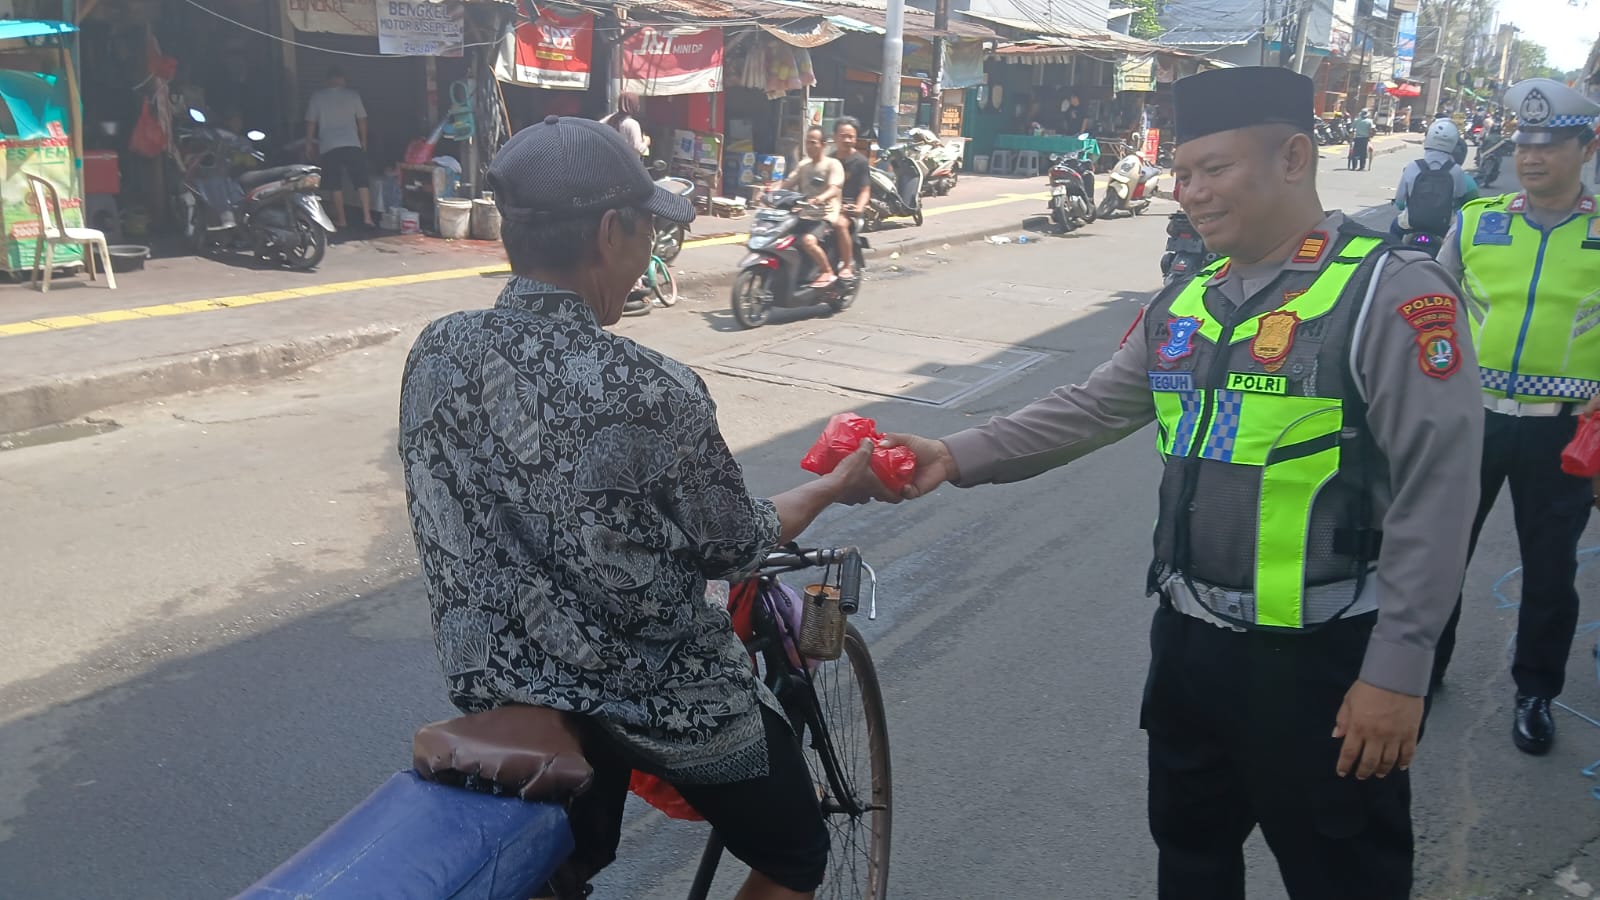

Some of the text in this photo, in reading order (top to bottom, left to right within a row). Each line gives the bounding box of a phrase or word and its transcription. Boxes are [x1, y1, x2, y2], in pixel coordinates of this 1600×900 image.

[389, 2, 450, 19] BENGKEL
[380, 18, 412, 31] MOTOR
[414, 22, 422, 31] &
[632, 31, 679, 55] J&T
[34, 147, 67, 158] TEH
[1402, 296, 1452, 315] POLDA
[1151, 376, 1189, 390] TEGUH
[1233, 375, 1281, 391] POLRI
